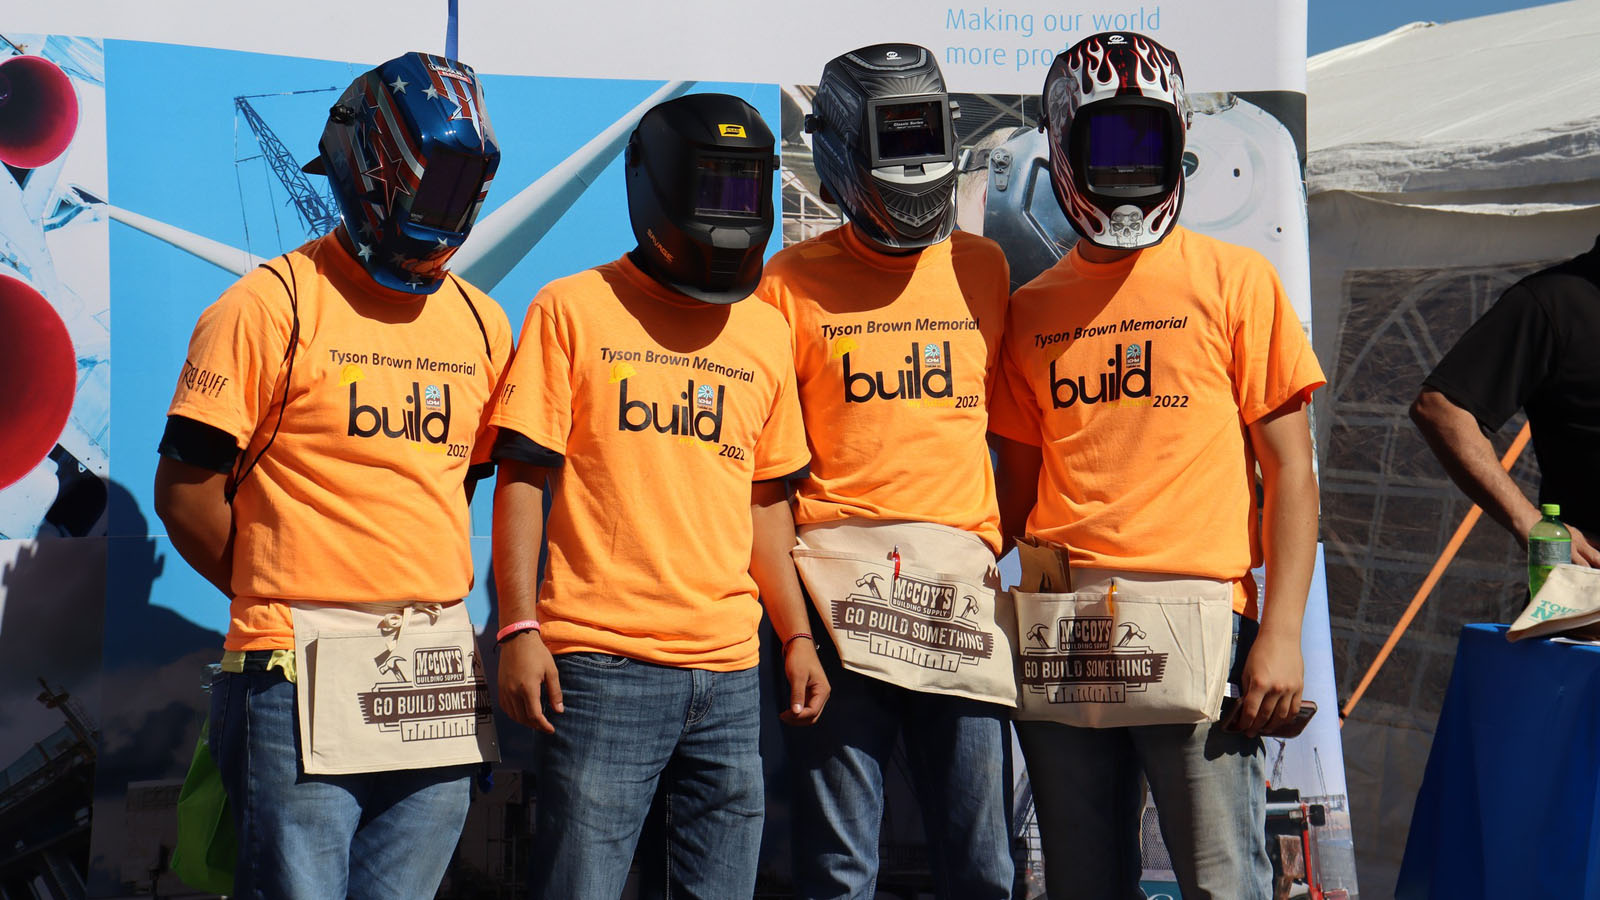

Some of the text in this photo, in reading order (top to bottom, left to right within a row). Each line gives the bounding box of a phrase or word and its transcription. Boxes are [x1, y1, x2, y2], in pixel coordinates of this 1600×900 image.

[946, 6, 1161, 38] Making our world
[946, 46, 1006, 66] more
[821, 318, 979, 340] Tyson Brown Memorial
[1034, 316, 1188, 349] Tyson Brown Memorial
[329, 349, 476, 376] Tyson Brown Memorial
[600, 348, 755, 383] Tyson Brown Memorial
[842, 341, 954, 403] build
[197, 369, 229, 392] CLIFF
[1049, 340, 1152, 409] build
[347, 381, 452, 444] build
[618, 377, 726, 443] build
[955, 395, 979, 409] 2022
[1153, 395, 1189, 408] 2022
[446, 444, 469, 458] 2022
[718, 444, 745, 461] 2022
[892, 599, 947, 617] BUILDING SUPPLY
[845, 607, 984, 650] GO BUILD SOMETHING
[416, 673, 463, 684] BUILDING SUPPLY
[1024, 658, 1152, 678] GO BUILD SOMETHING
[373, 697, 393, 716] GO
[397, 694, 435, 714] BUILD
